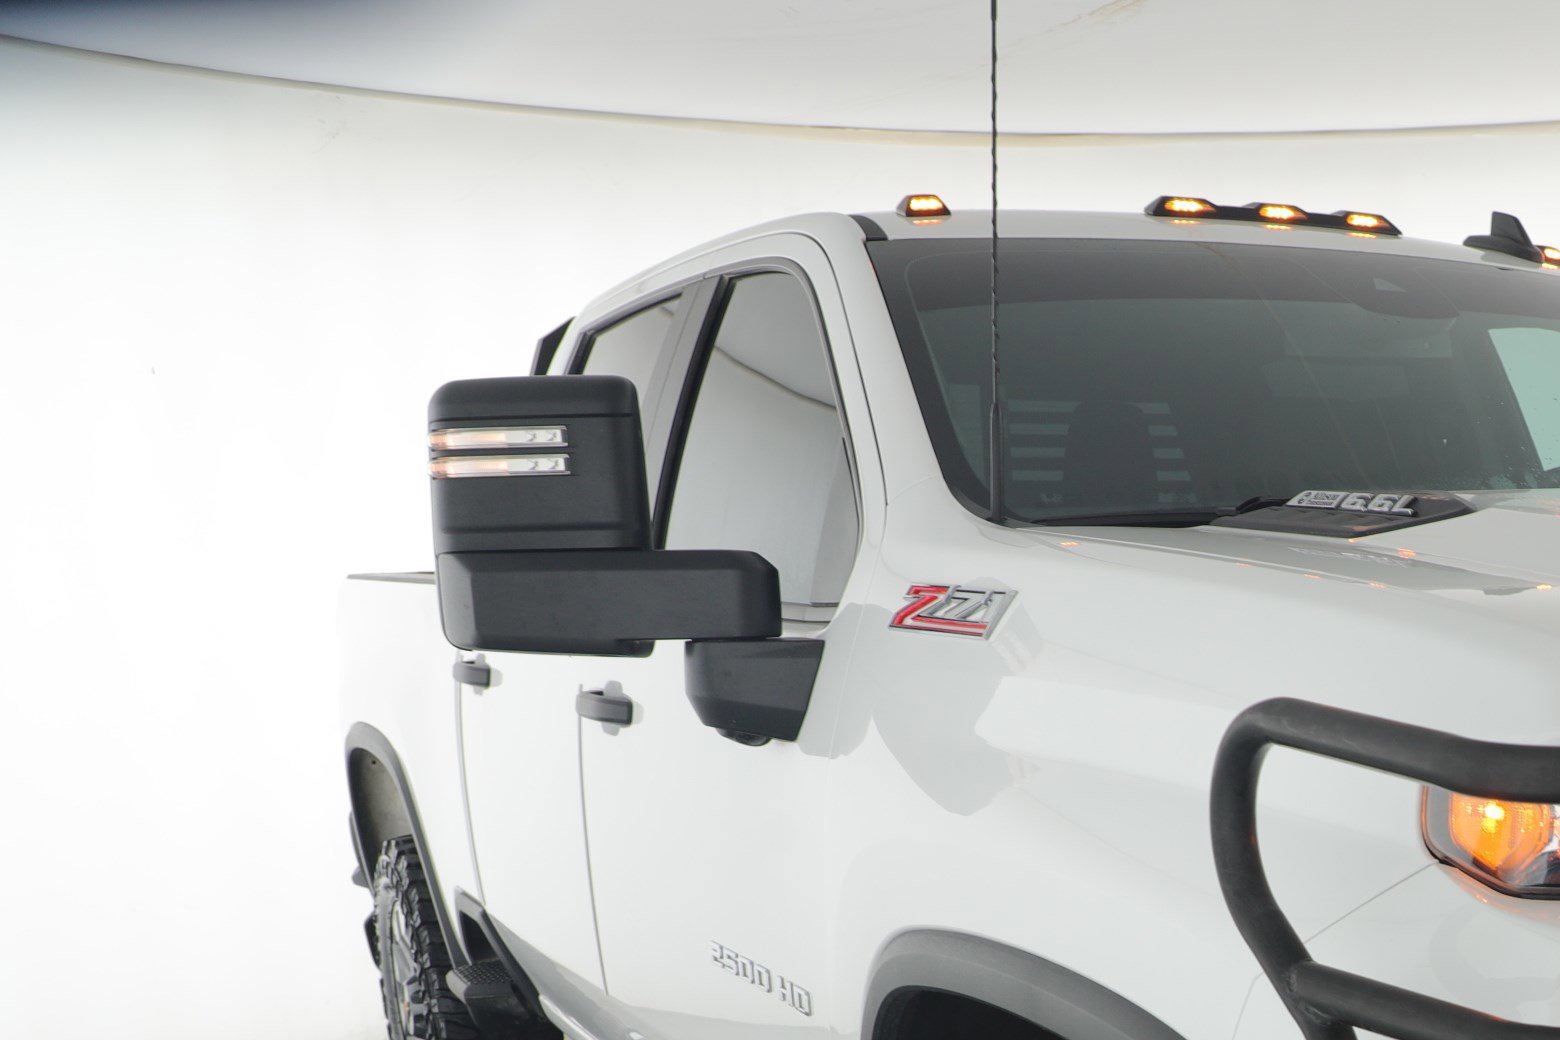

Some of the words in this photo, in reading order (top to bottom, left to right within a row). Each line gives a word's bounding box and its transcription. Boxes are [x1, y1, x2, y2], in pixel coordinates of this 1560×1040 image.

[889, 582, 1019, 640] Z71
[709, 939, 773, 994] 2500
[777, 974, 813, 1017] HD
